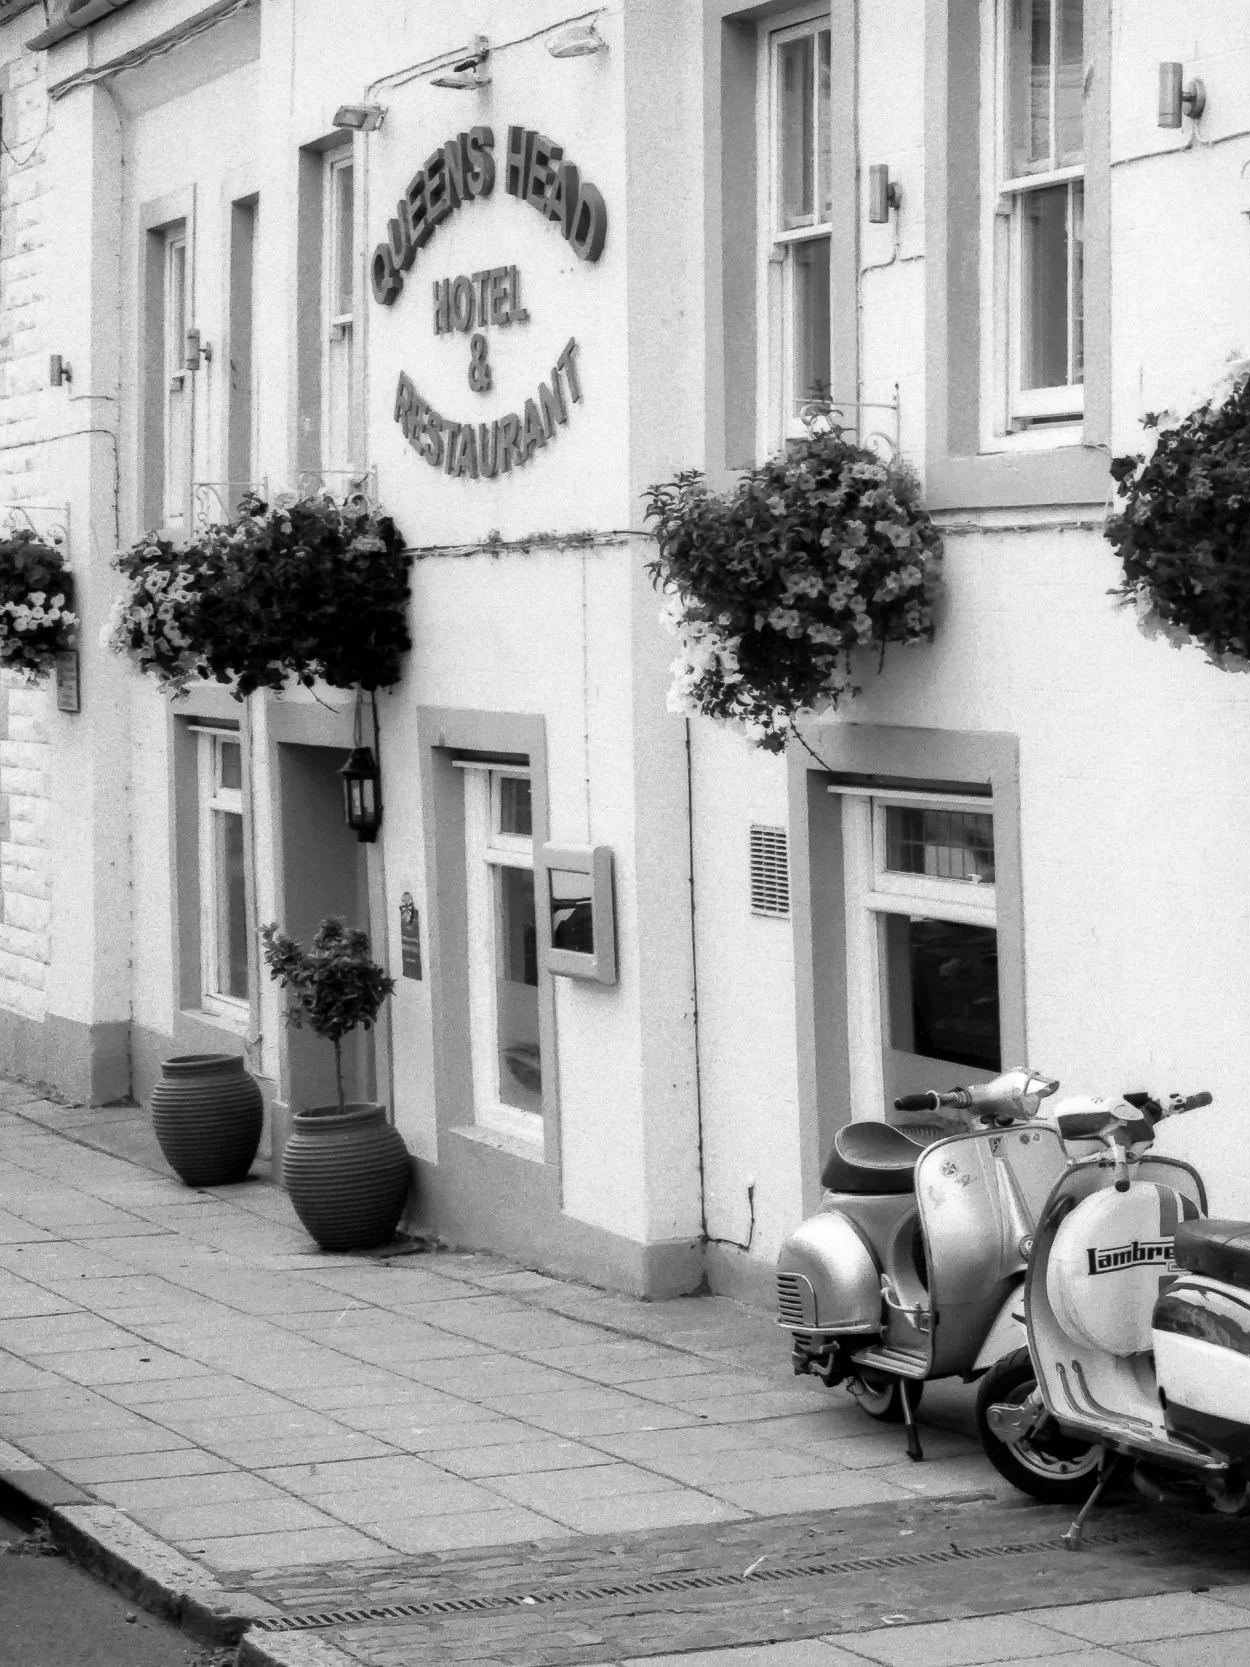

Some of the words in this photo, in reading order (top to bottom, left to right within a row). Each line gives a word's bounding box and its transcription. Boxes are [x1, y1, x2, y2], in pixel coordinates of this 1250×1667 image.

[371, 126, 495, 306] QUEENS
[506, 126, 607, 262] HEAD
[432, 265, 530, 335] HOTEL
[393, 337, 583, 479] RESTAURANT
[468, 333, 492, 393] &
